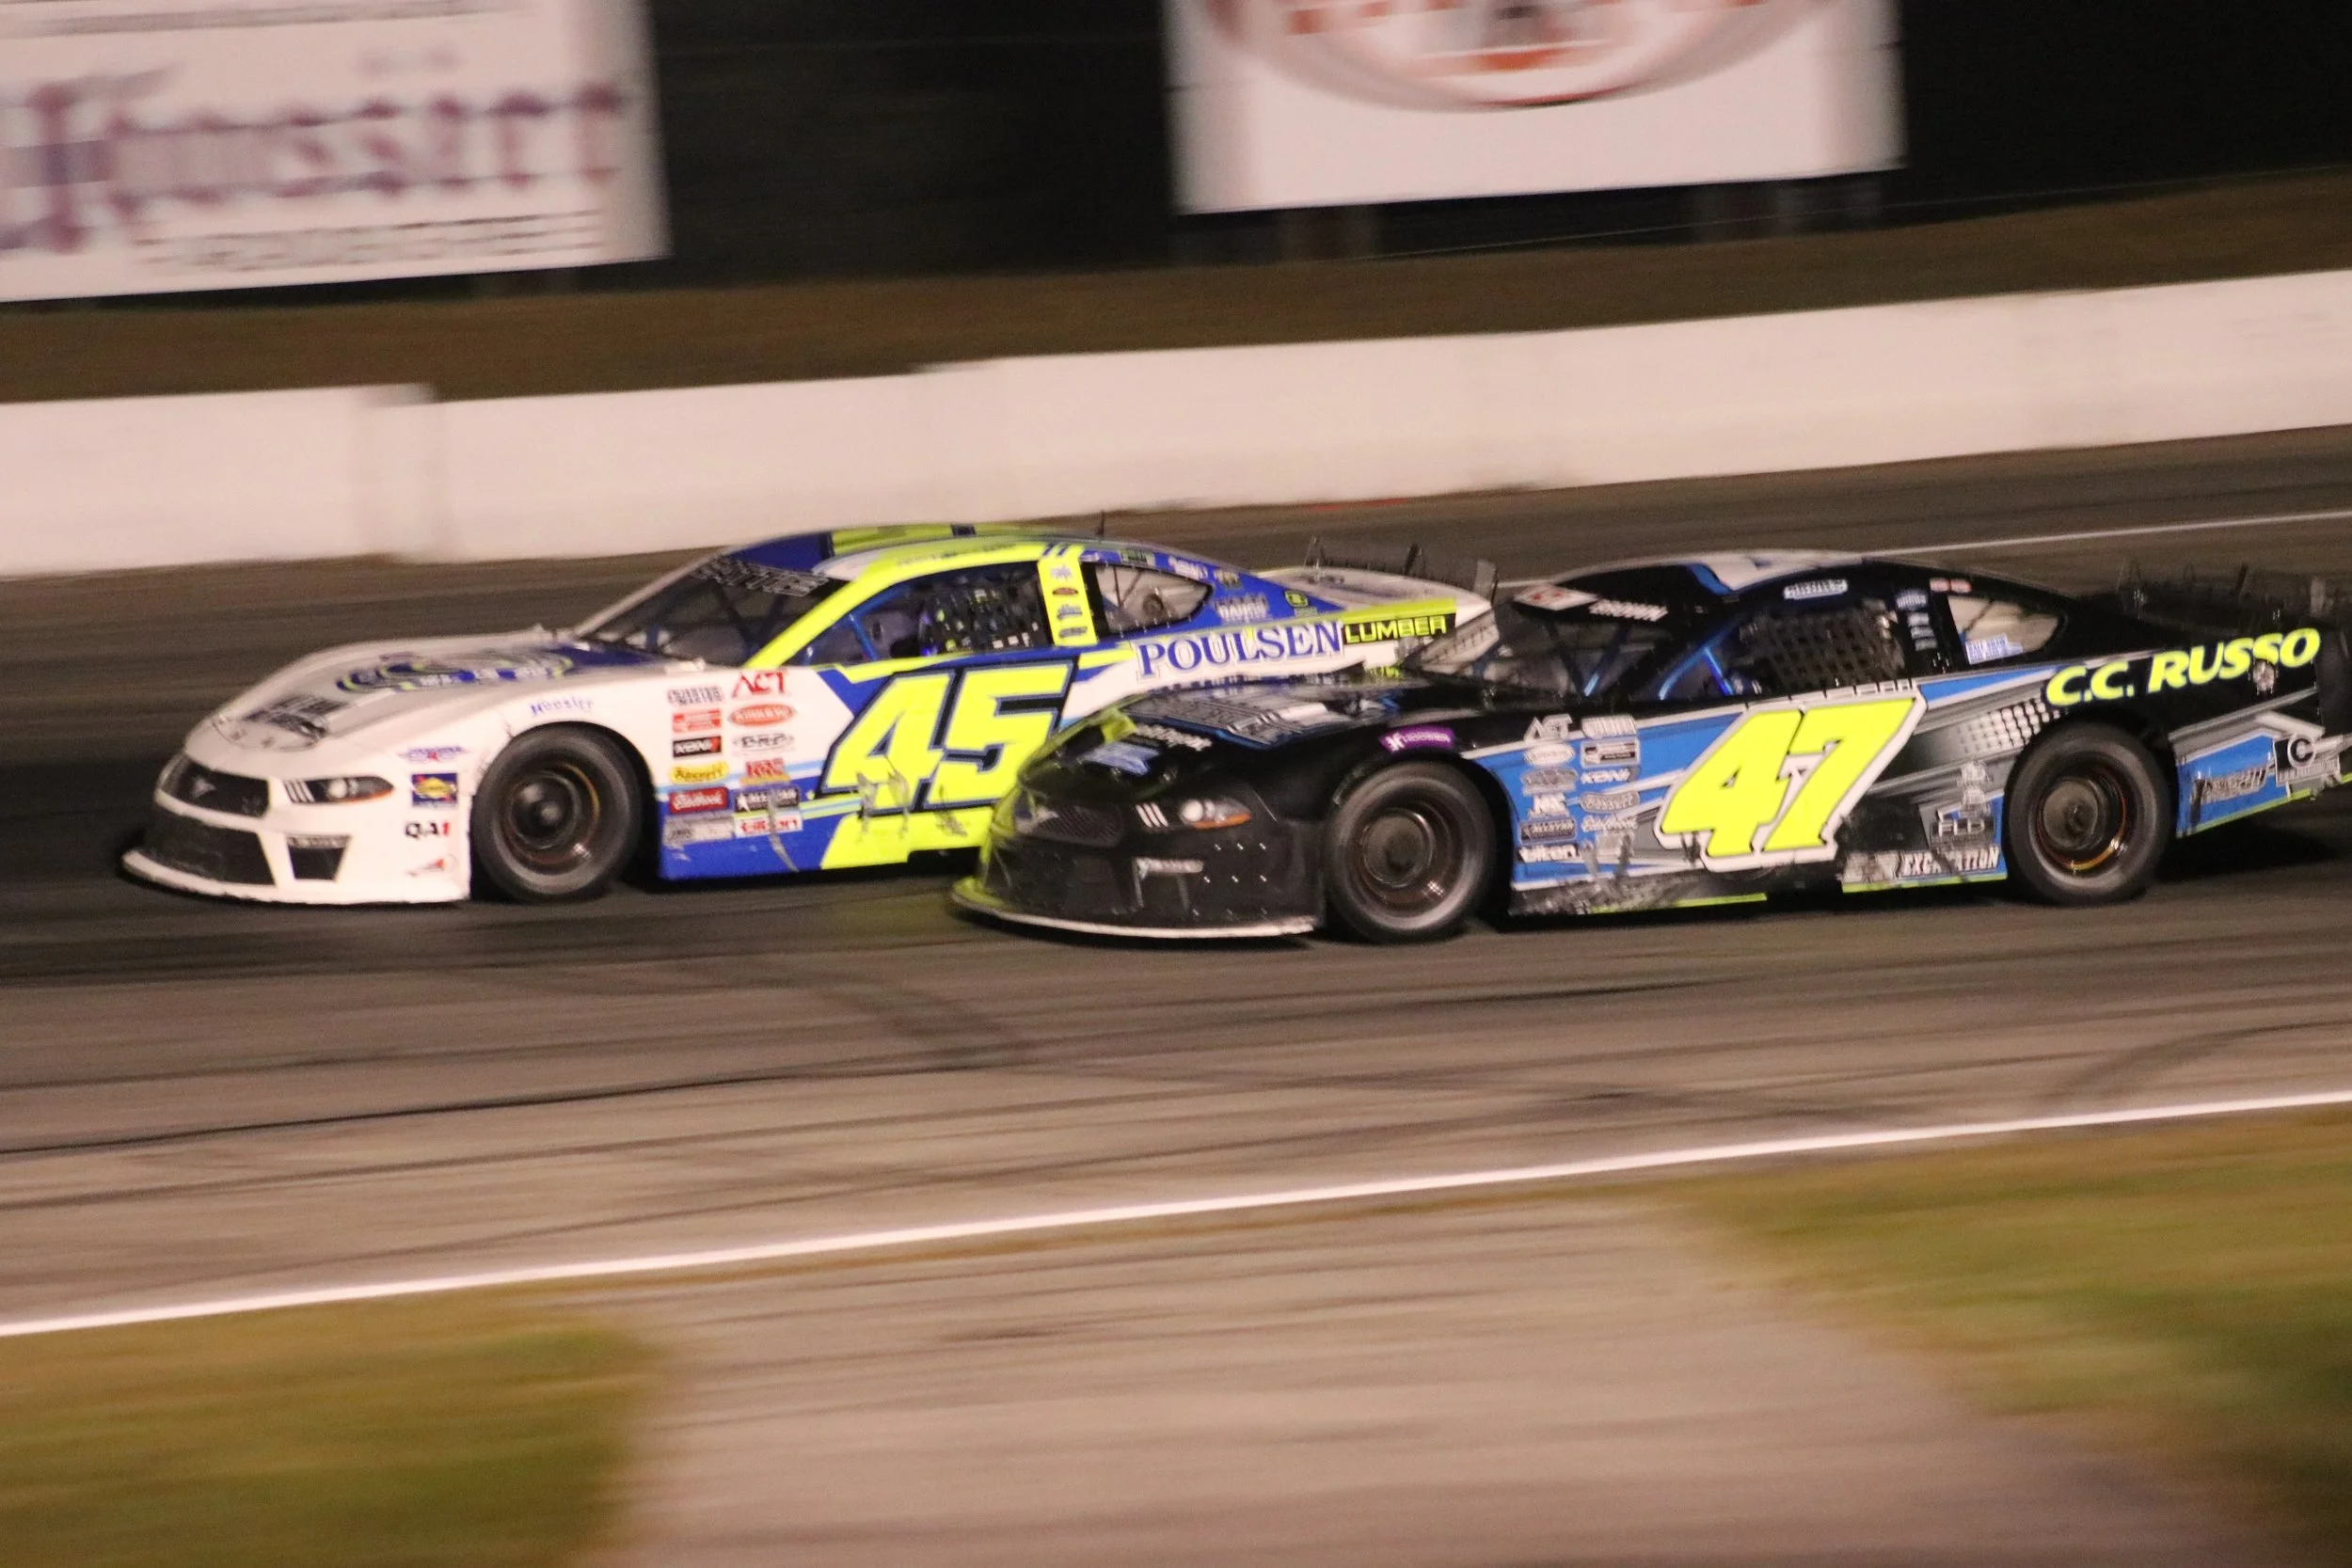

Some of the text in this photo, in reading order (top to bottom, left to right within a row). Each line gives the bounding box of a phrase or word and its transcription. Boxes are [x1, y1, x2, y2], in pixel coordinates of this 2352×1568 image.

[1136, 615, 1447, 679] POULSEN LUMBER
[2045, 627, 2321, 706] C.C. RUSSO
[820, 662, 1073, 813] 45
[1660, 697, 1916, 858] 47
[1900, 846, 2000, 876] EXCAATION
